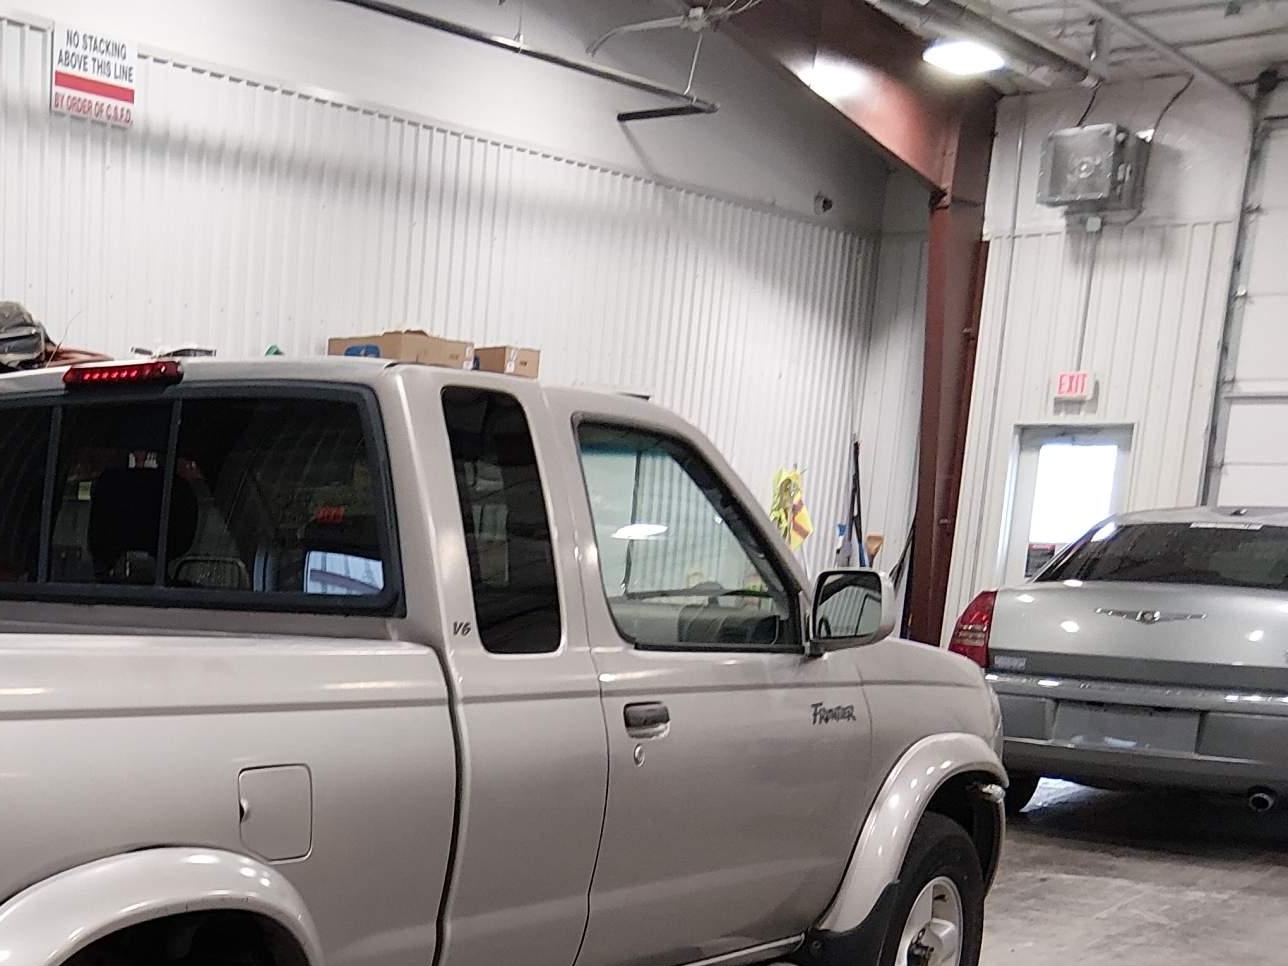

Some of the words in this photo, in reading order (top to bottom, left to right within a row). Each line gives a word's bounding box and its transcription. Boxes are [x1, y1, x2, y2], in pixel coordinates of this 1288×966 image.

[66, 29, 80, 49] NO
[82, 33, 127, 60] STACKING
[57, 48, 88, 72] ABOVE
[91, 56, 111, 78] THIS
[113, 62, 133, 83] LINE
[67, 95, 92, 115] ORDER
[94, 101, 104, 118] OF
[1057, 373, 1087, 394] EXIT
[453, 621, 471, 636] V6
